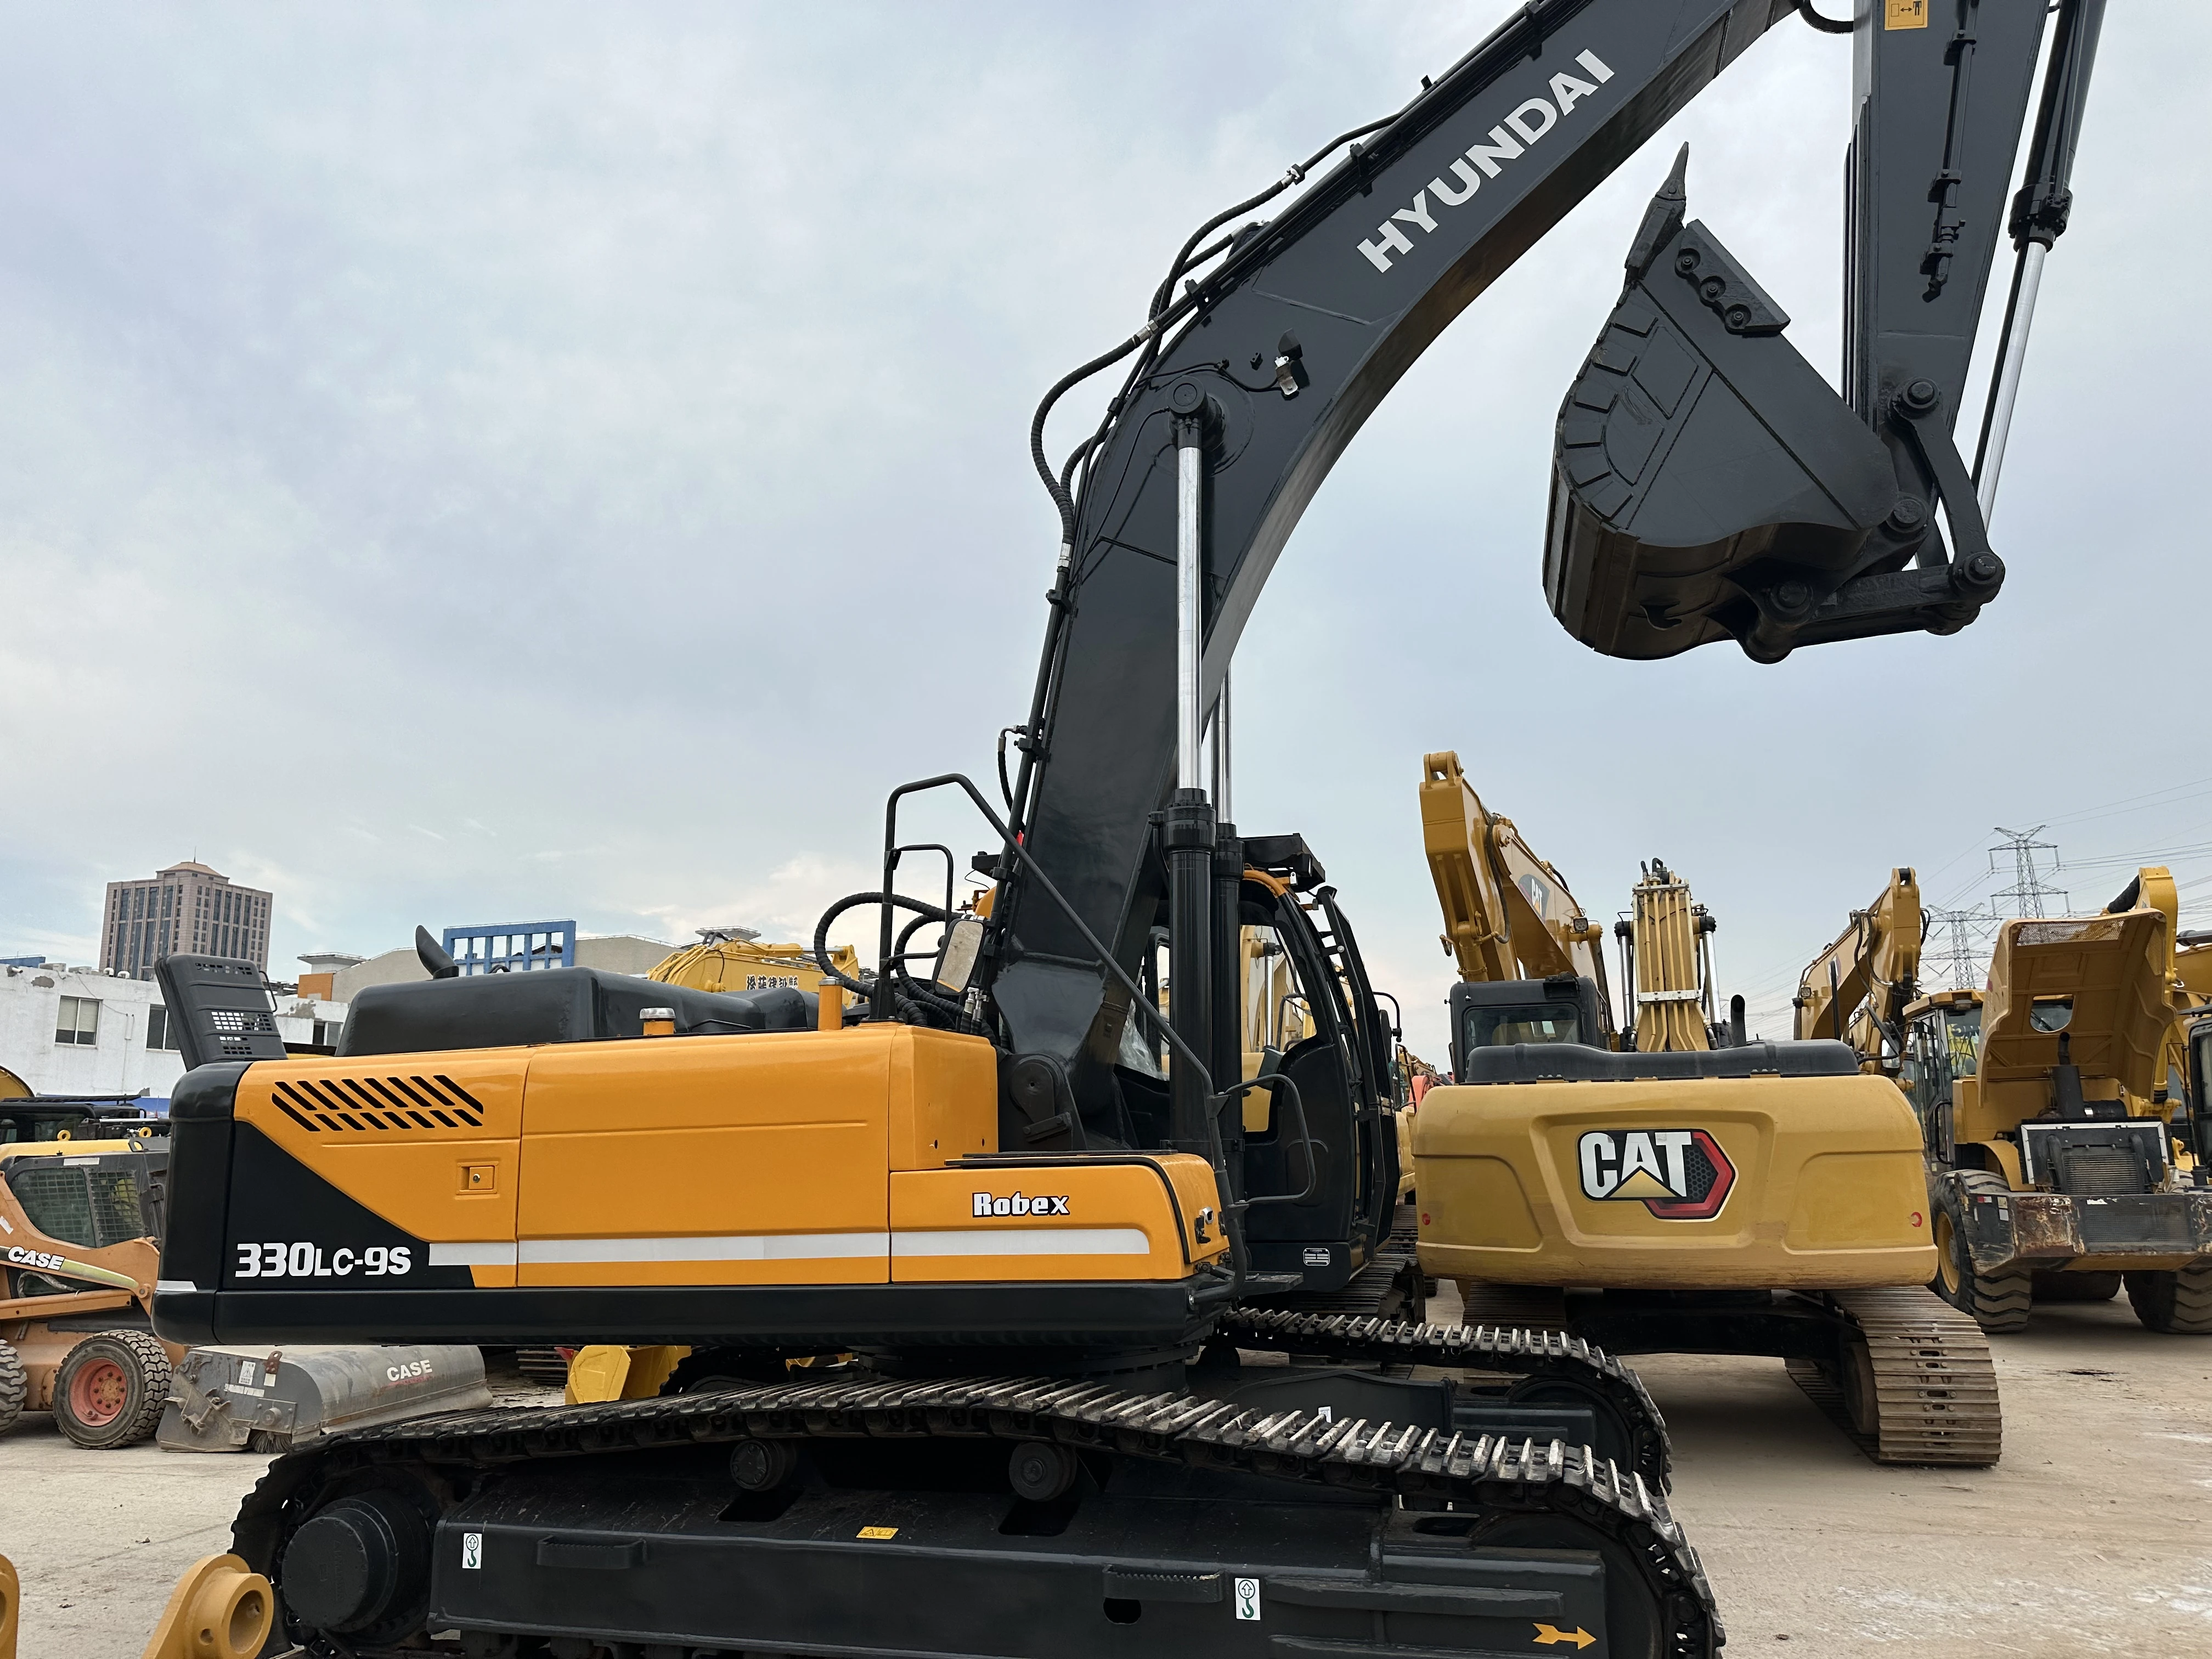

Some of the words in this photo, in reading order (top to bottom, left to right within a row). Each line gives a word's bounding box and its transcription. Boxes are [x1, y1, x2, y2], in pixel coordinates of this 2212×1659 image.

[1356, 48, 1615, 274] HYUNDAI
[1531, 878, 1543, 917] CAT
[1580, 1131, 1692, 1198] CAT
[973, 1192, 1069, 1216] Robex
[8, 1246, 65, 1271] CASE
[235, 1242, 411, 1277] 330LC-9S
[387, 1359, 432, 1381] CASE
